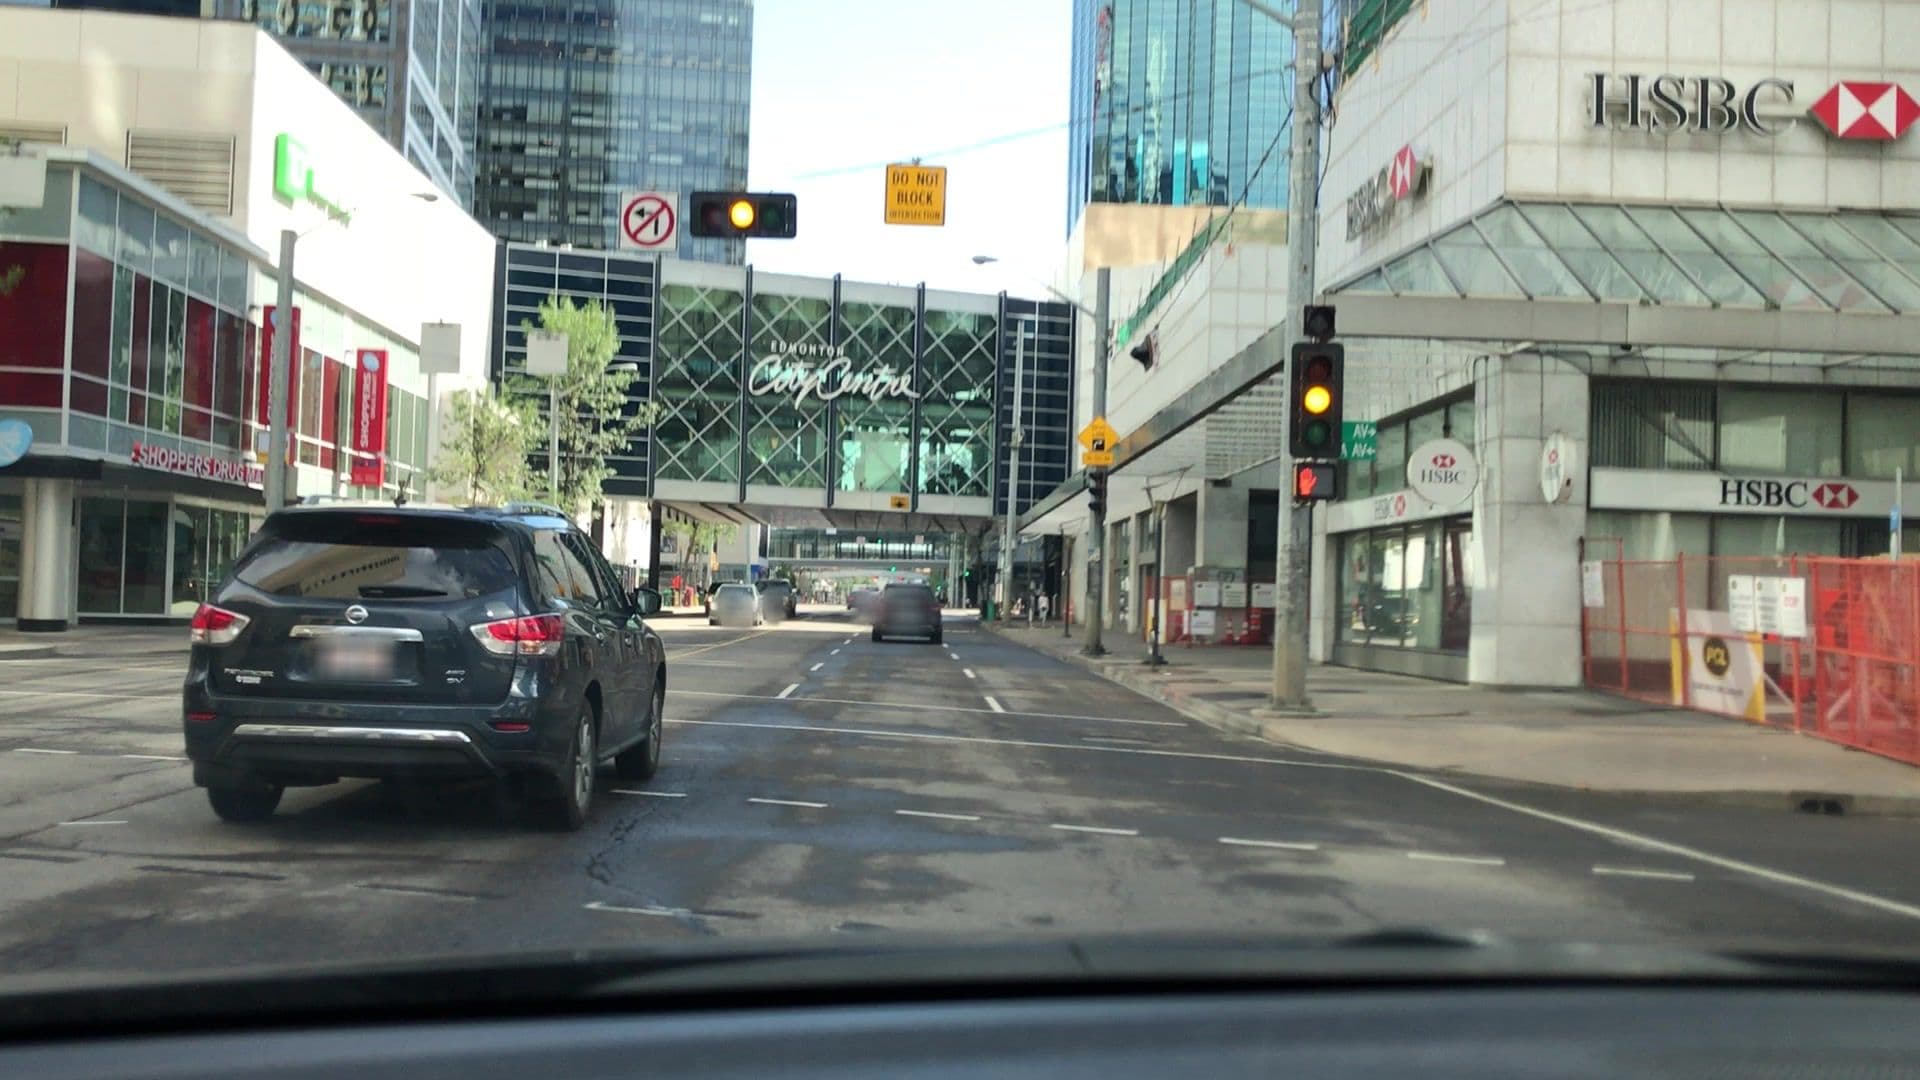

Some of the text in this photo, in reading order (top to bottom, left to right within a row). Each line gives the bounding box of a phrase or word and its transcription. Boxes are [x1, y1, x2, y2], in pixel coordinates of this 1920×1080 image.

[1585, 73, 1797, 134] HSBC
[892, 171, 939, 187] DO NOT
[896, 190, 933, 206] BLOCK
[1345, 165, 1392, 242] HSBC
[770, 339, 845, 356] EDMONTON
[748, 354, 921, 410] City Centre
[361, 370, 372, 449] SHOPPERS
[1352, 423, 1369, 439] AV
[1351, 443, 1367, 458] AV
[139, 443, 265, 486] SHOPPERS DRUG MA
[1421, 468, 1463, 484] HSBC
[1719, 478, 1808, 509] HSBC
